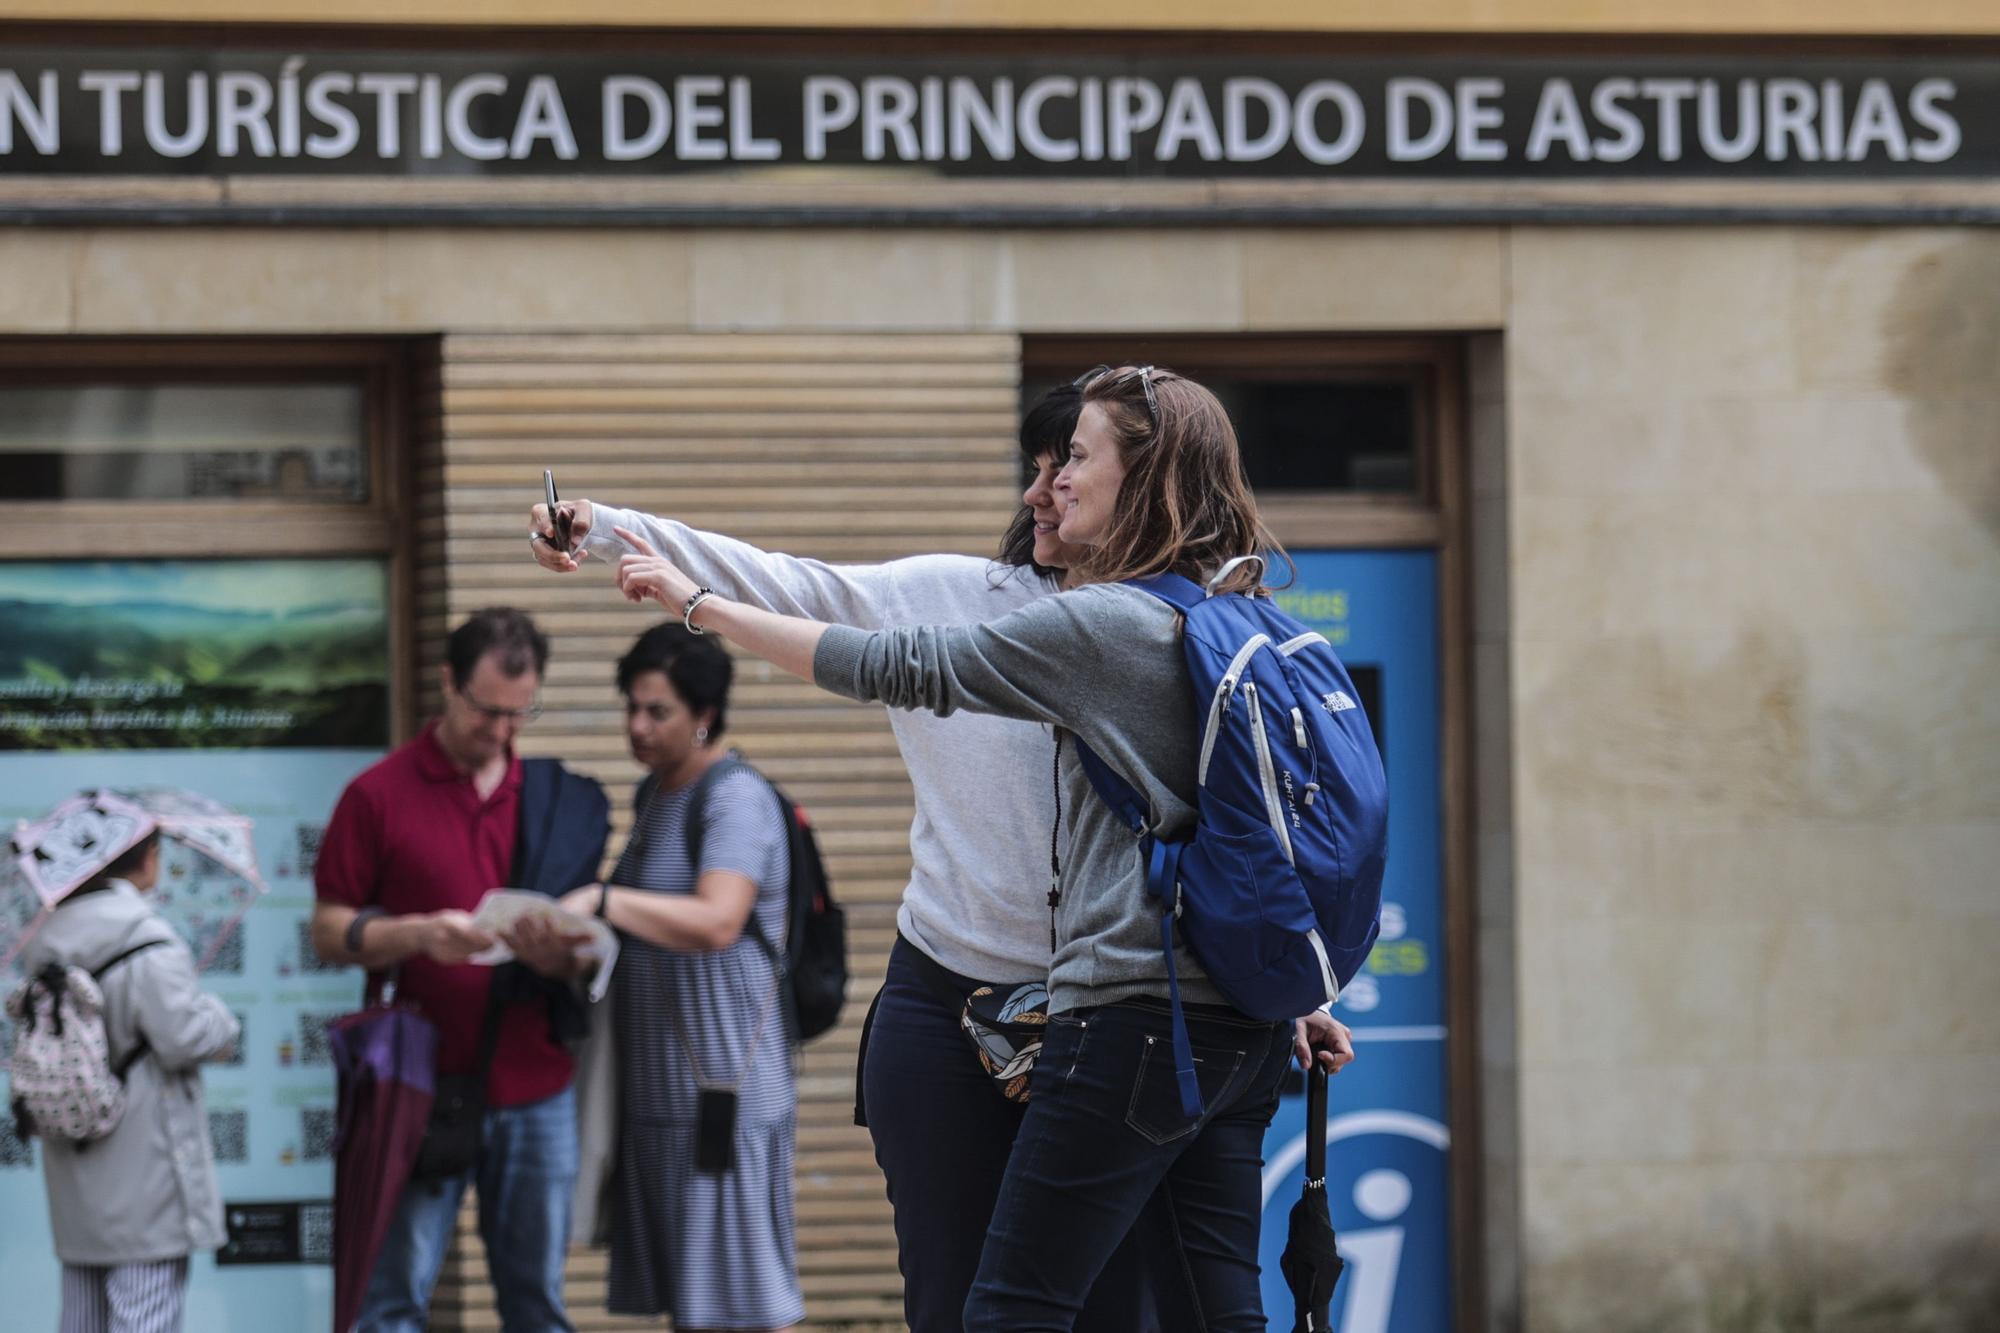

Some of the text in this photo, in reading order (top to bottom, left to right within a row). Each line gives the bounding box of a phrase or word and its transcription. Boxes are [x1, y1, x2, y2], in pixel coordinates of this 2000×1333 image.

[79, 54, 578, 160] TURÍSTICA
[603, 76, 782, 161] DEL
[803, 76, 1366, 165] PRINCIPADO
[1386, 77, 1508, 162] DE
[1525, 77, 1962, 163] ASTURIAS
